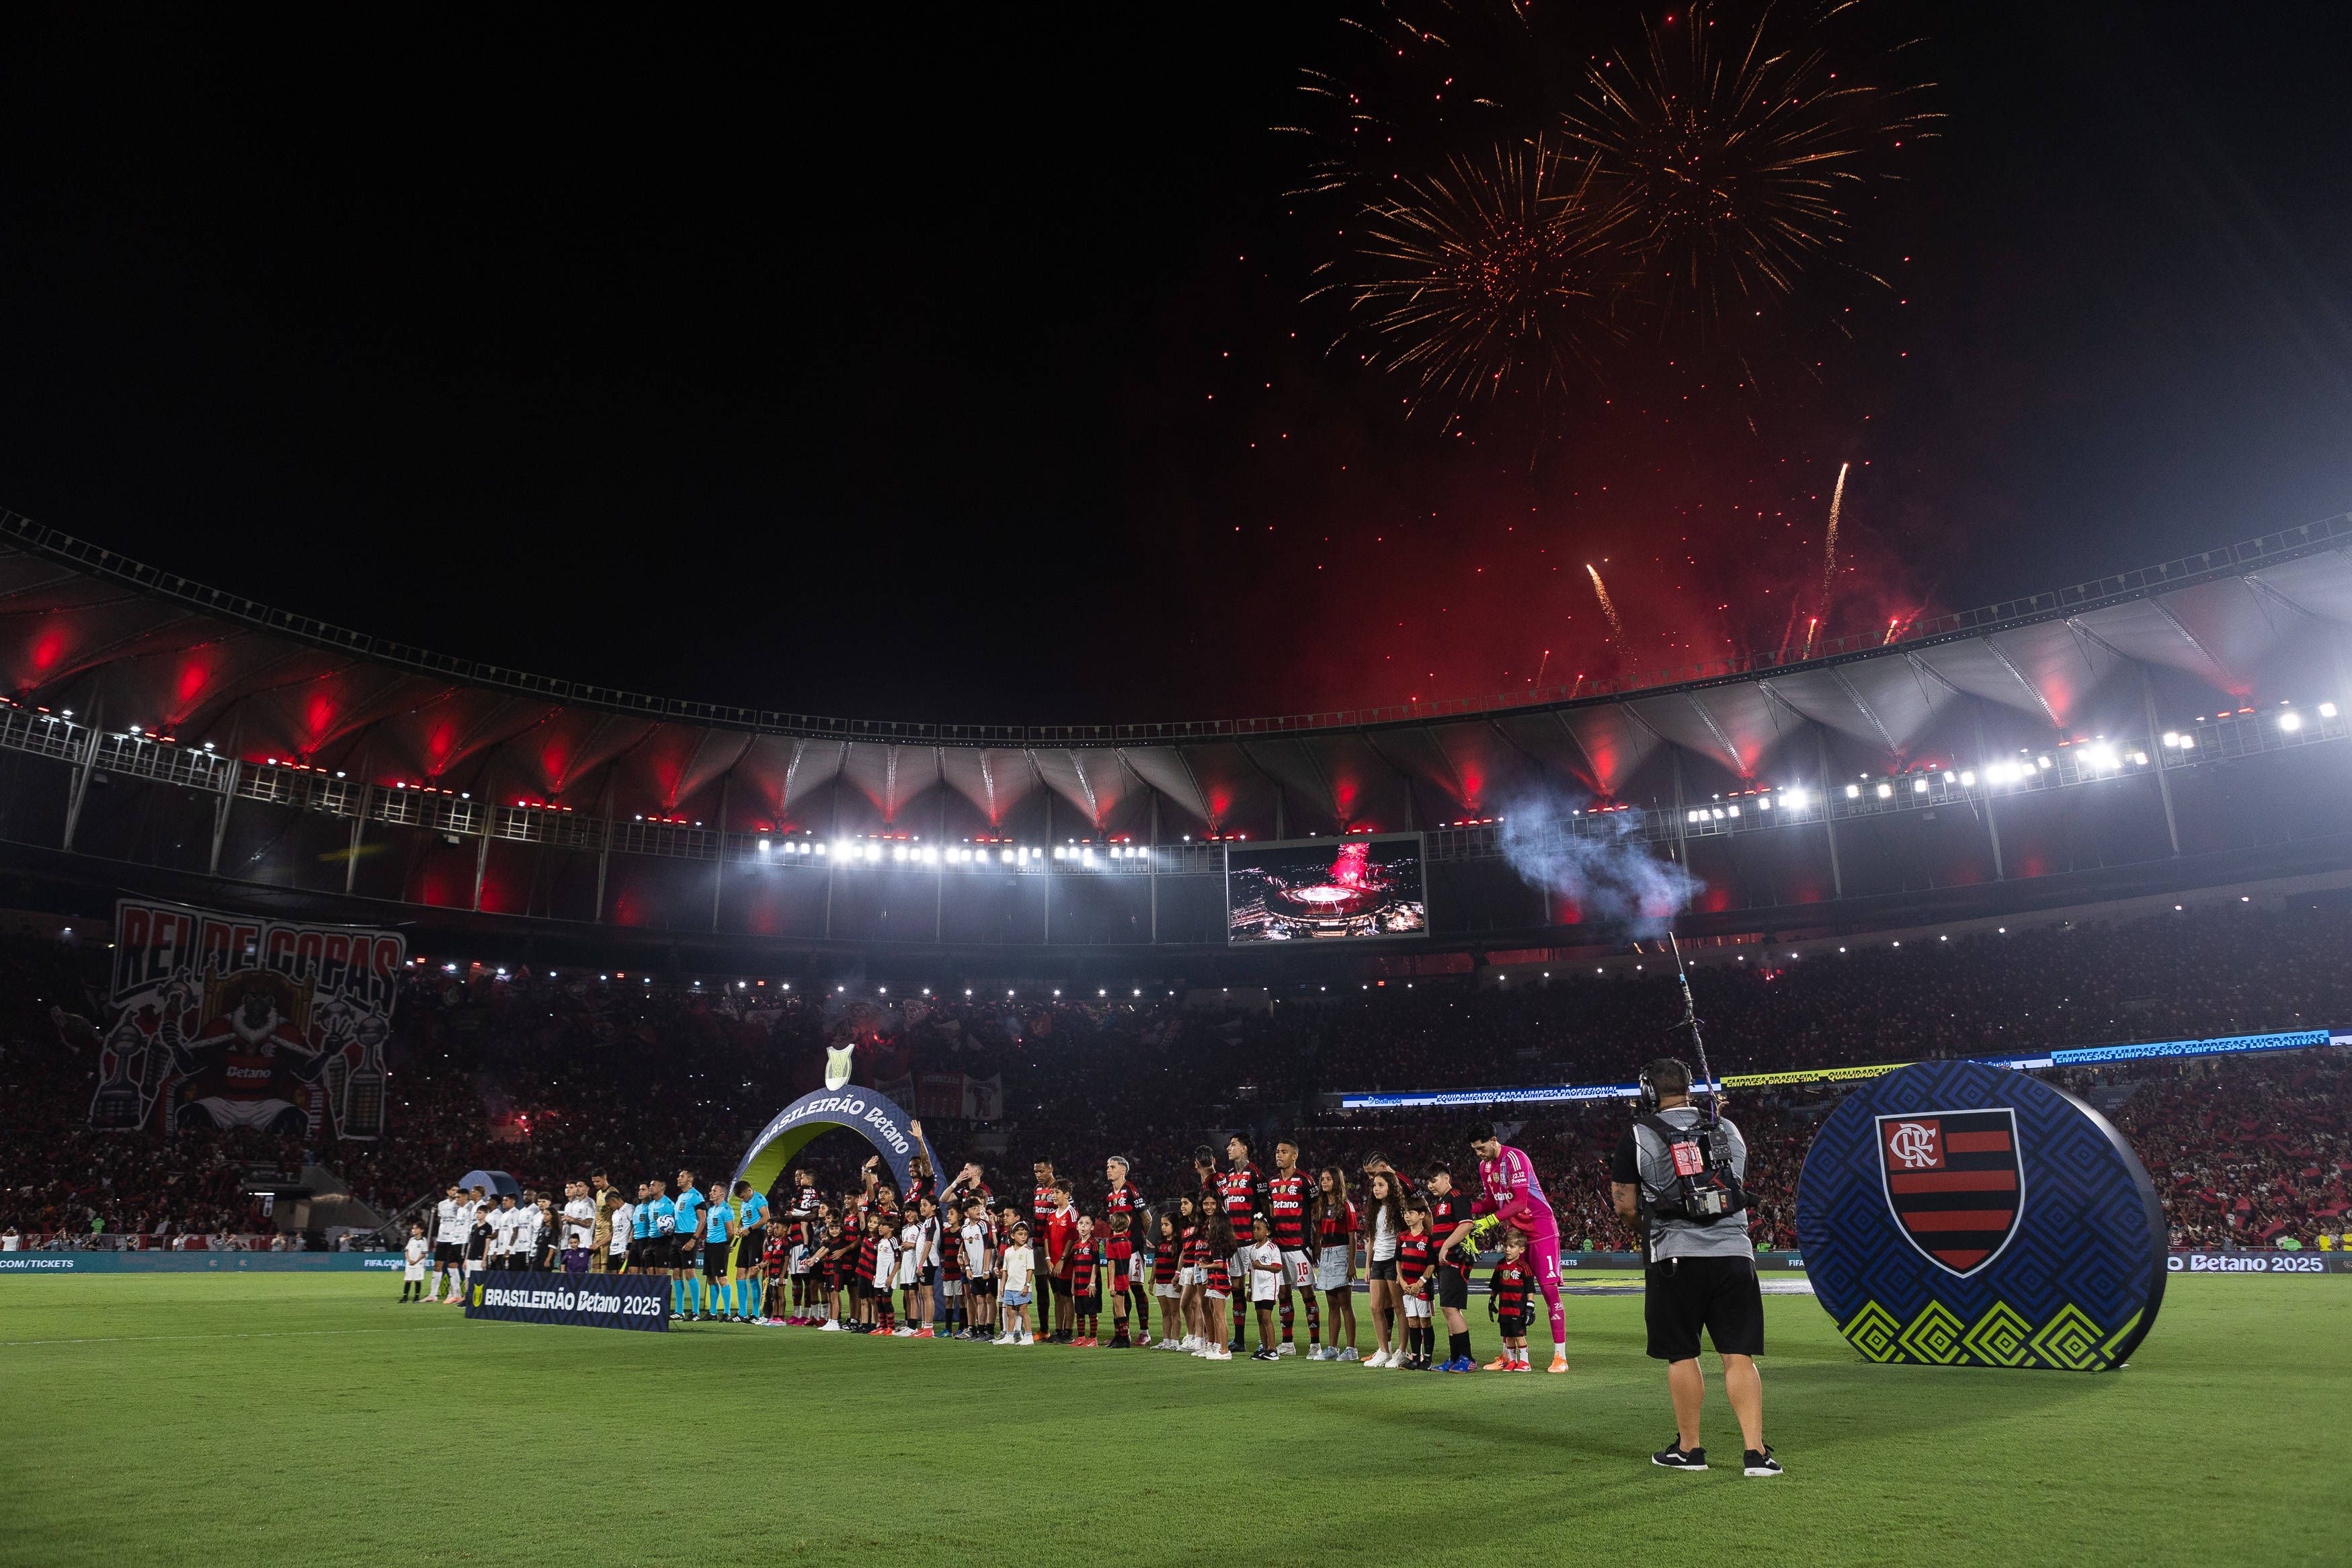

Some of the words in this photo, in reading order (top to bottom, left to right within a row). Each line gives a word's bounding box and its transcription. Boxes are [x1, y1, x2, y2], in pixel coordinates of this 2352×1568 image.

[115, 906, 191, 996] REI
[202, 921, 257, 977] DE
[268, 928, 399, 1014] COPAS
[2056, 1050, 2112, 1064] EMPRESAS
[2115, 1045, 2156, 1059] LIMPAS
[2158, 1042, 2182, 1056] SÃO
[2185, 1040, 2247, 1054] EMPRESAS
[2250, 1033, 2324, 1049] LUCRATIVAS
[1727, 1077, 1767, 1087] EMPRESA
[1828, 1069, 1880, 1082] QUALIDADE
[1436, 1092, 1498, 1102] EQUIPAMENTOS
[1500, 1091, 1521, 1100] PARA
[1523, 1089, 1559, 1098] LIMPEZA
[1560, 1086, 1618, 1097] PROFISSIONAL
[747, 1094, 865, 1163] BRASILEIRÃO
[864, 1107, 909, 1154] Betano
[1228, 1195, 1246, 1203] etano
[1494, 1192, 1513, 1201] etano
[1273, 1200, 1299, 1208] Betano
[1135, 1259, 1140, 1270] 2
[1297, 1262, 1309, 1276] 16
[1546, 1255, 1553, 1270] 1
[2191, 1254, 2267, 1272] Betano
[2271, 1257, 2324, 1272] 2025
[485, 1287, 575, 1311] BRASILEIRÃO
[577, 1290, 621, 1313] Betano
[623, 1295, 661, 1316] 2025
